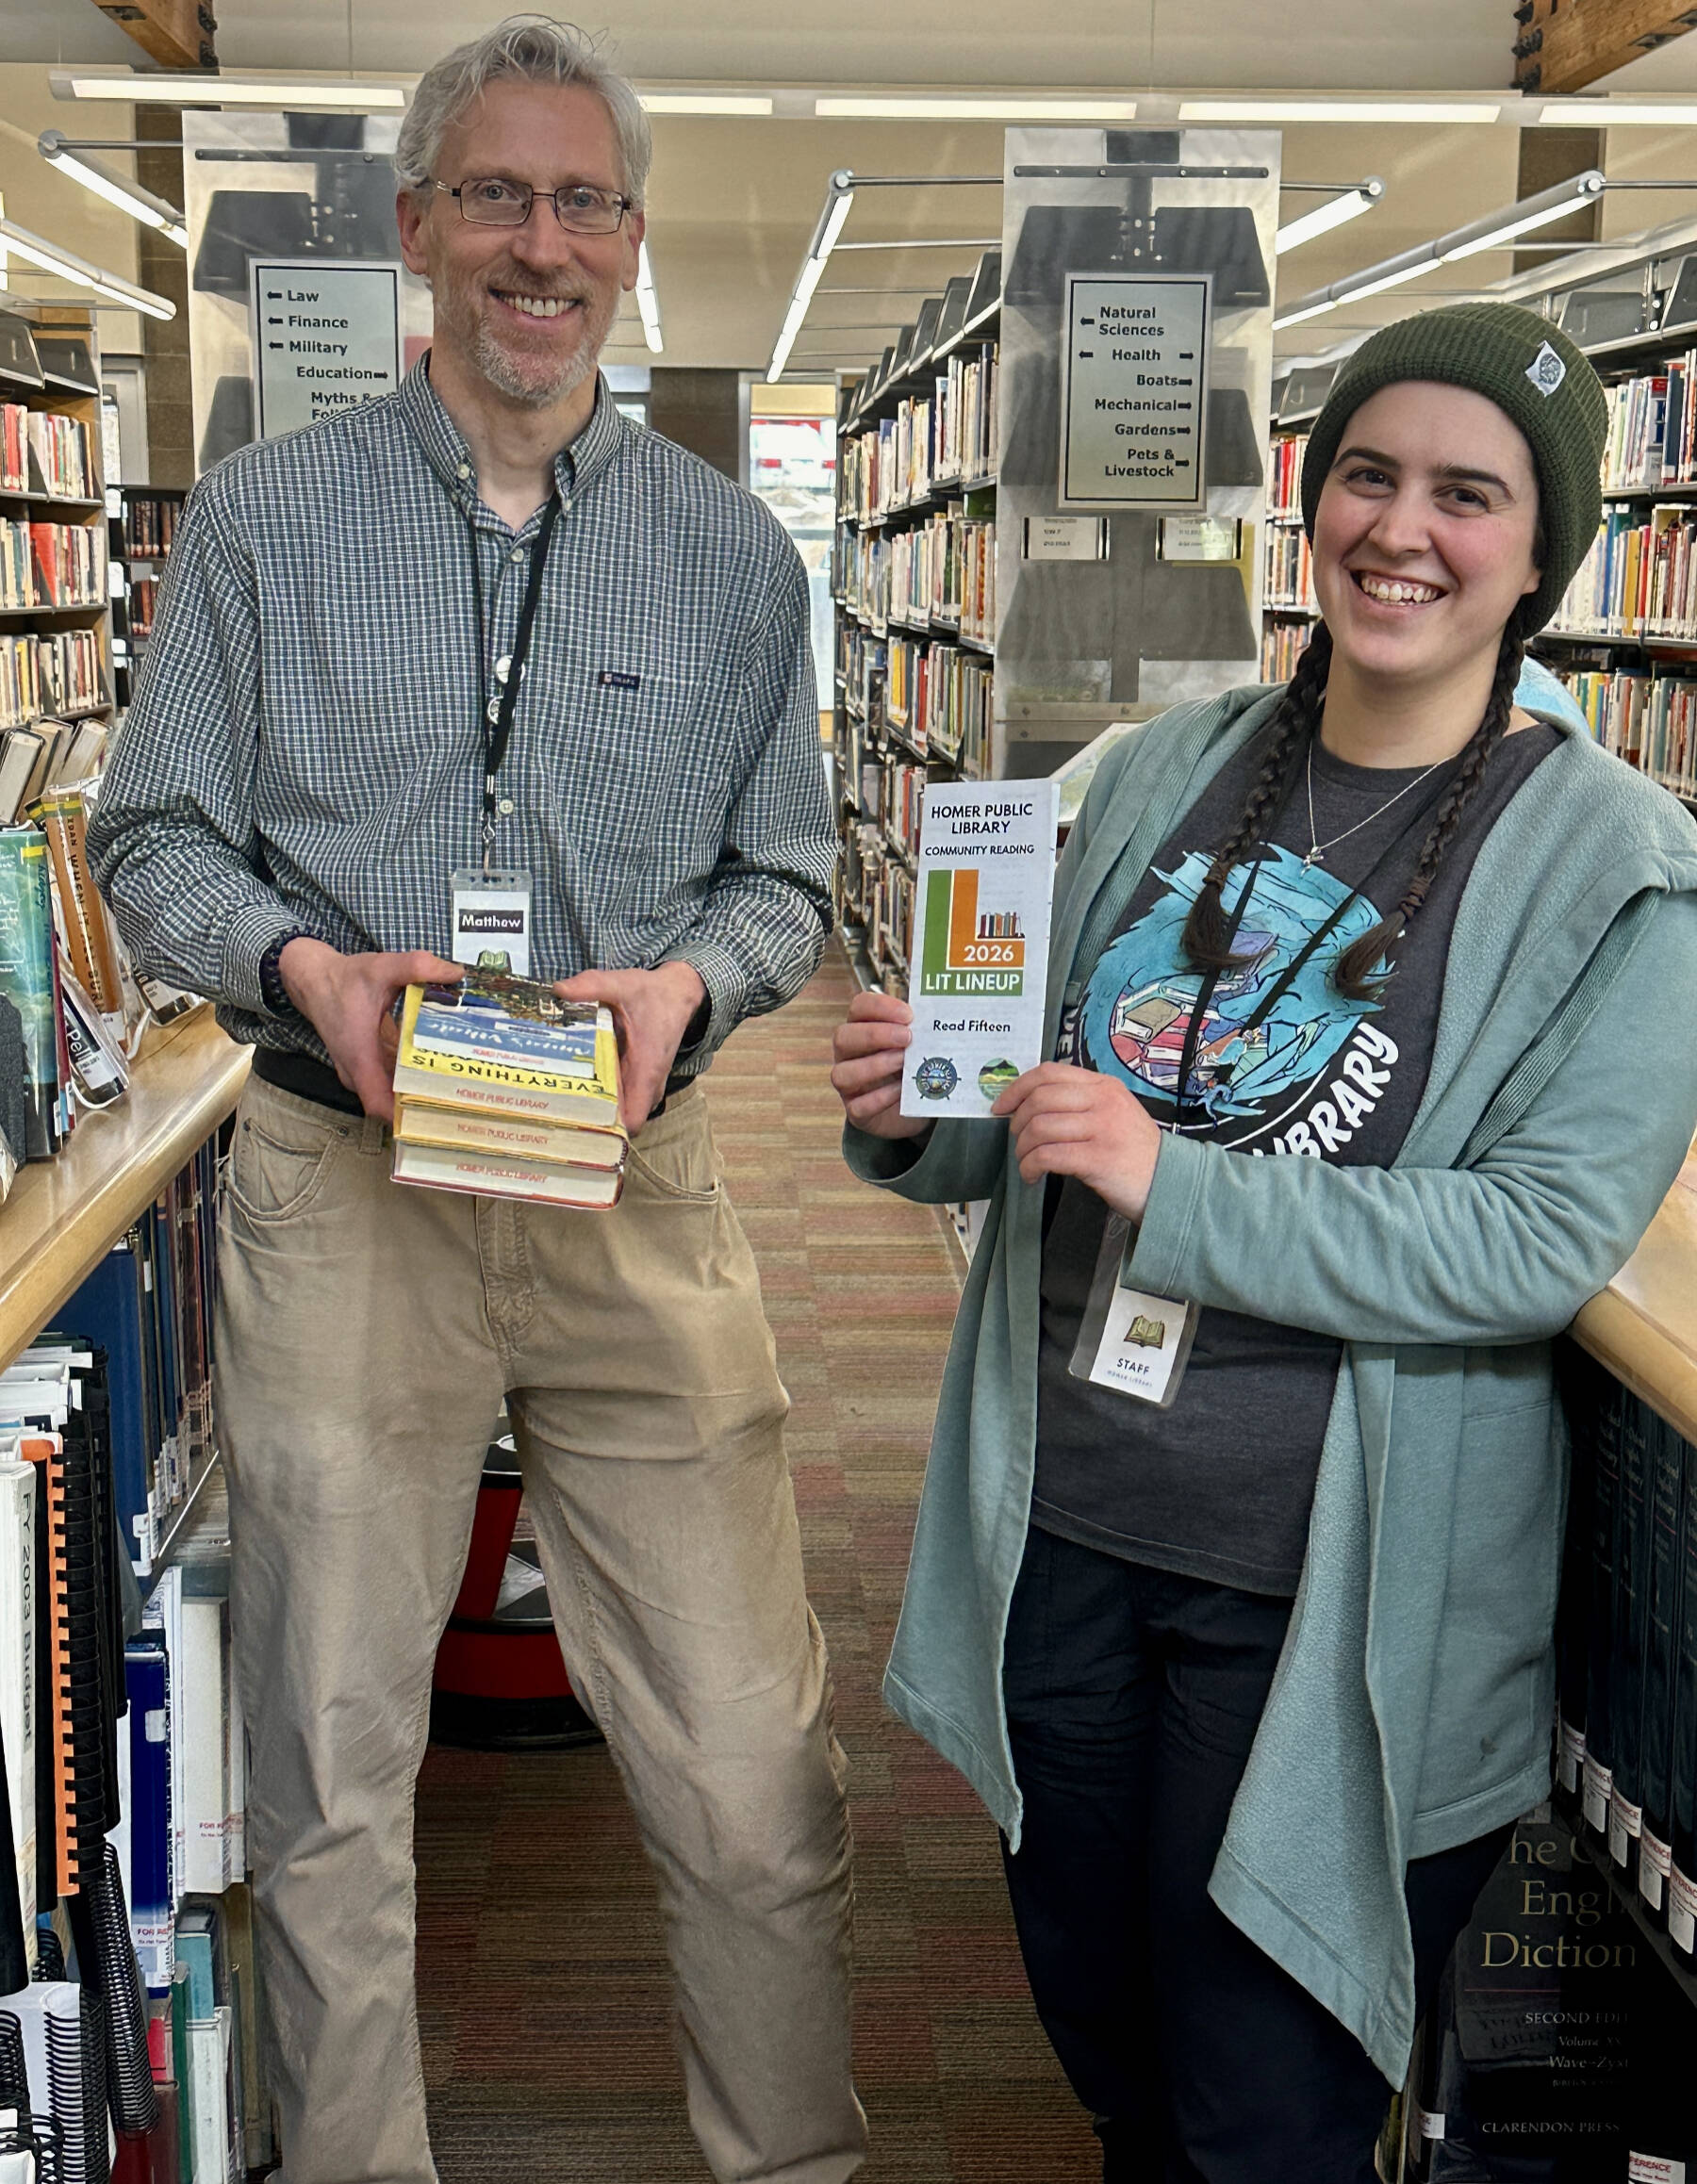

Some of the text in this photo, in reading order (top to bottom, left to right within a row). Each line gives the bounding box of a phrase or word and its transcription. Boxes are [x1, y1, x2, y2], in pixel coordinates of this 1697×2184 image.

[288, 289, 320, 303] Law
[1100, 306, 1157, 319] Natural
[288, 315, 349, 329] Finance
[1098, 323, 1165, 337] Sciences
[289, 340, 348, 356] Military
[1112, 349, 1162, 361] Health
[296, 366, 373, 380] Education
[1136, 374, 1178, 386] Boats
[311, 391, 357, 406] Myths
[1095, 399, 1178, 411] Mechanical
[1114, 423, 1177, 436] Gardens
[1127, 448, 1176, 460] Pets &
[1104, 466, 1175, 477] Livestock
[931, 803, 1033, 819] HOMER PUBLIC
[951, 821, 1011, 834] LIBRARY
[925, 845, 1035, 856] COMMUNITY READING
[462, 914, 521, 928] Matthew
[964, 944, 1014, 962] 2026
[925, 973, 1020, 991] LIT LINEUP
[933, 1020, 1011, 1033] Read Fifteen
[412, 1054, 605, 1094] EVERYTHING IS
[1252, 1022, 1399, 1160] IBRARY
[487, 1092, 515, 1106] PUBLIC
[515, 1096, 550, 1110] LIBRARY
[515, 1132, 549, 1145] LIBRARY
[1116, 1357, 1151, 1375] STAFF
[23, 1492, 31, 1532] FY
[23, 1545, 31, 1620] 2003
[1508, 1833, 1557, 1865] he
[1520, 1879, 1627, 1927] Engl
[1525, 2012, 1590, 2025] SECOND
[1557, 2035, 1600, 2047] Volume
[1482, 2121, 1622, 2134] CLARENDON PRESS
